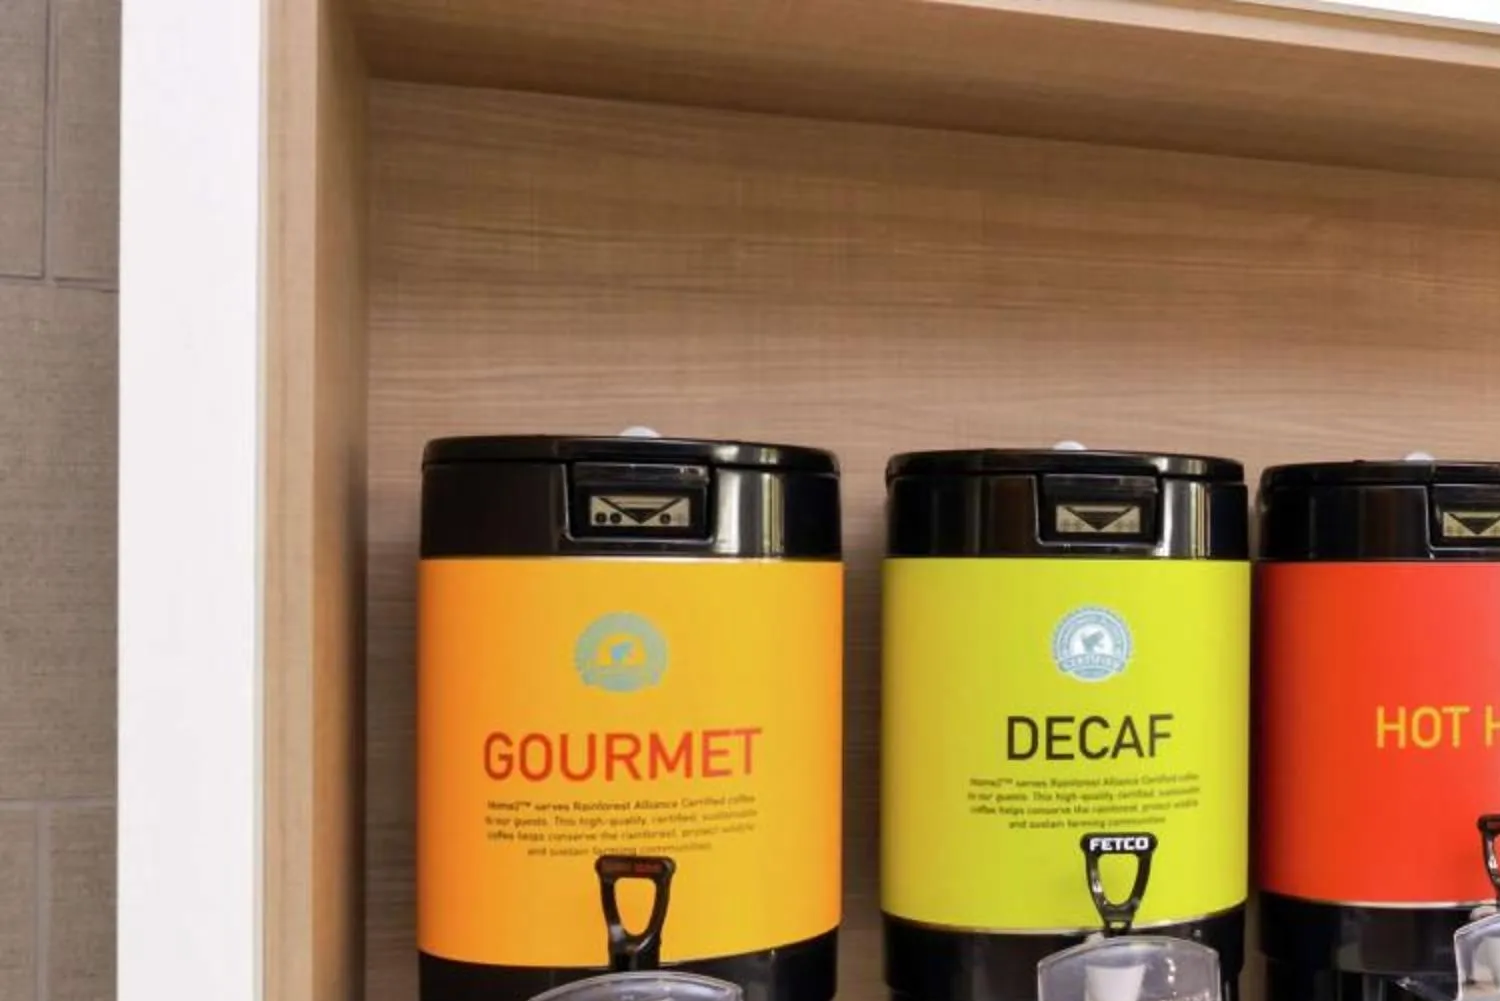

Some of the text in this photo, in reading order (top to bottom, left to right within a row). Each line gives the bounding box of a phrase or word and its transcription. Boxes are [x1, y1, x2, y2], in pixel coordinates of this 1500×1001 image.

[1006, 712, 1174, 762] DECAF
[1376, 705, 1470, 749] HOT
[483, 727, 763, 783] GOURMET
[1088, 836, 1150, 852] FETCO
